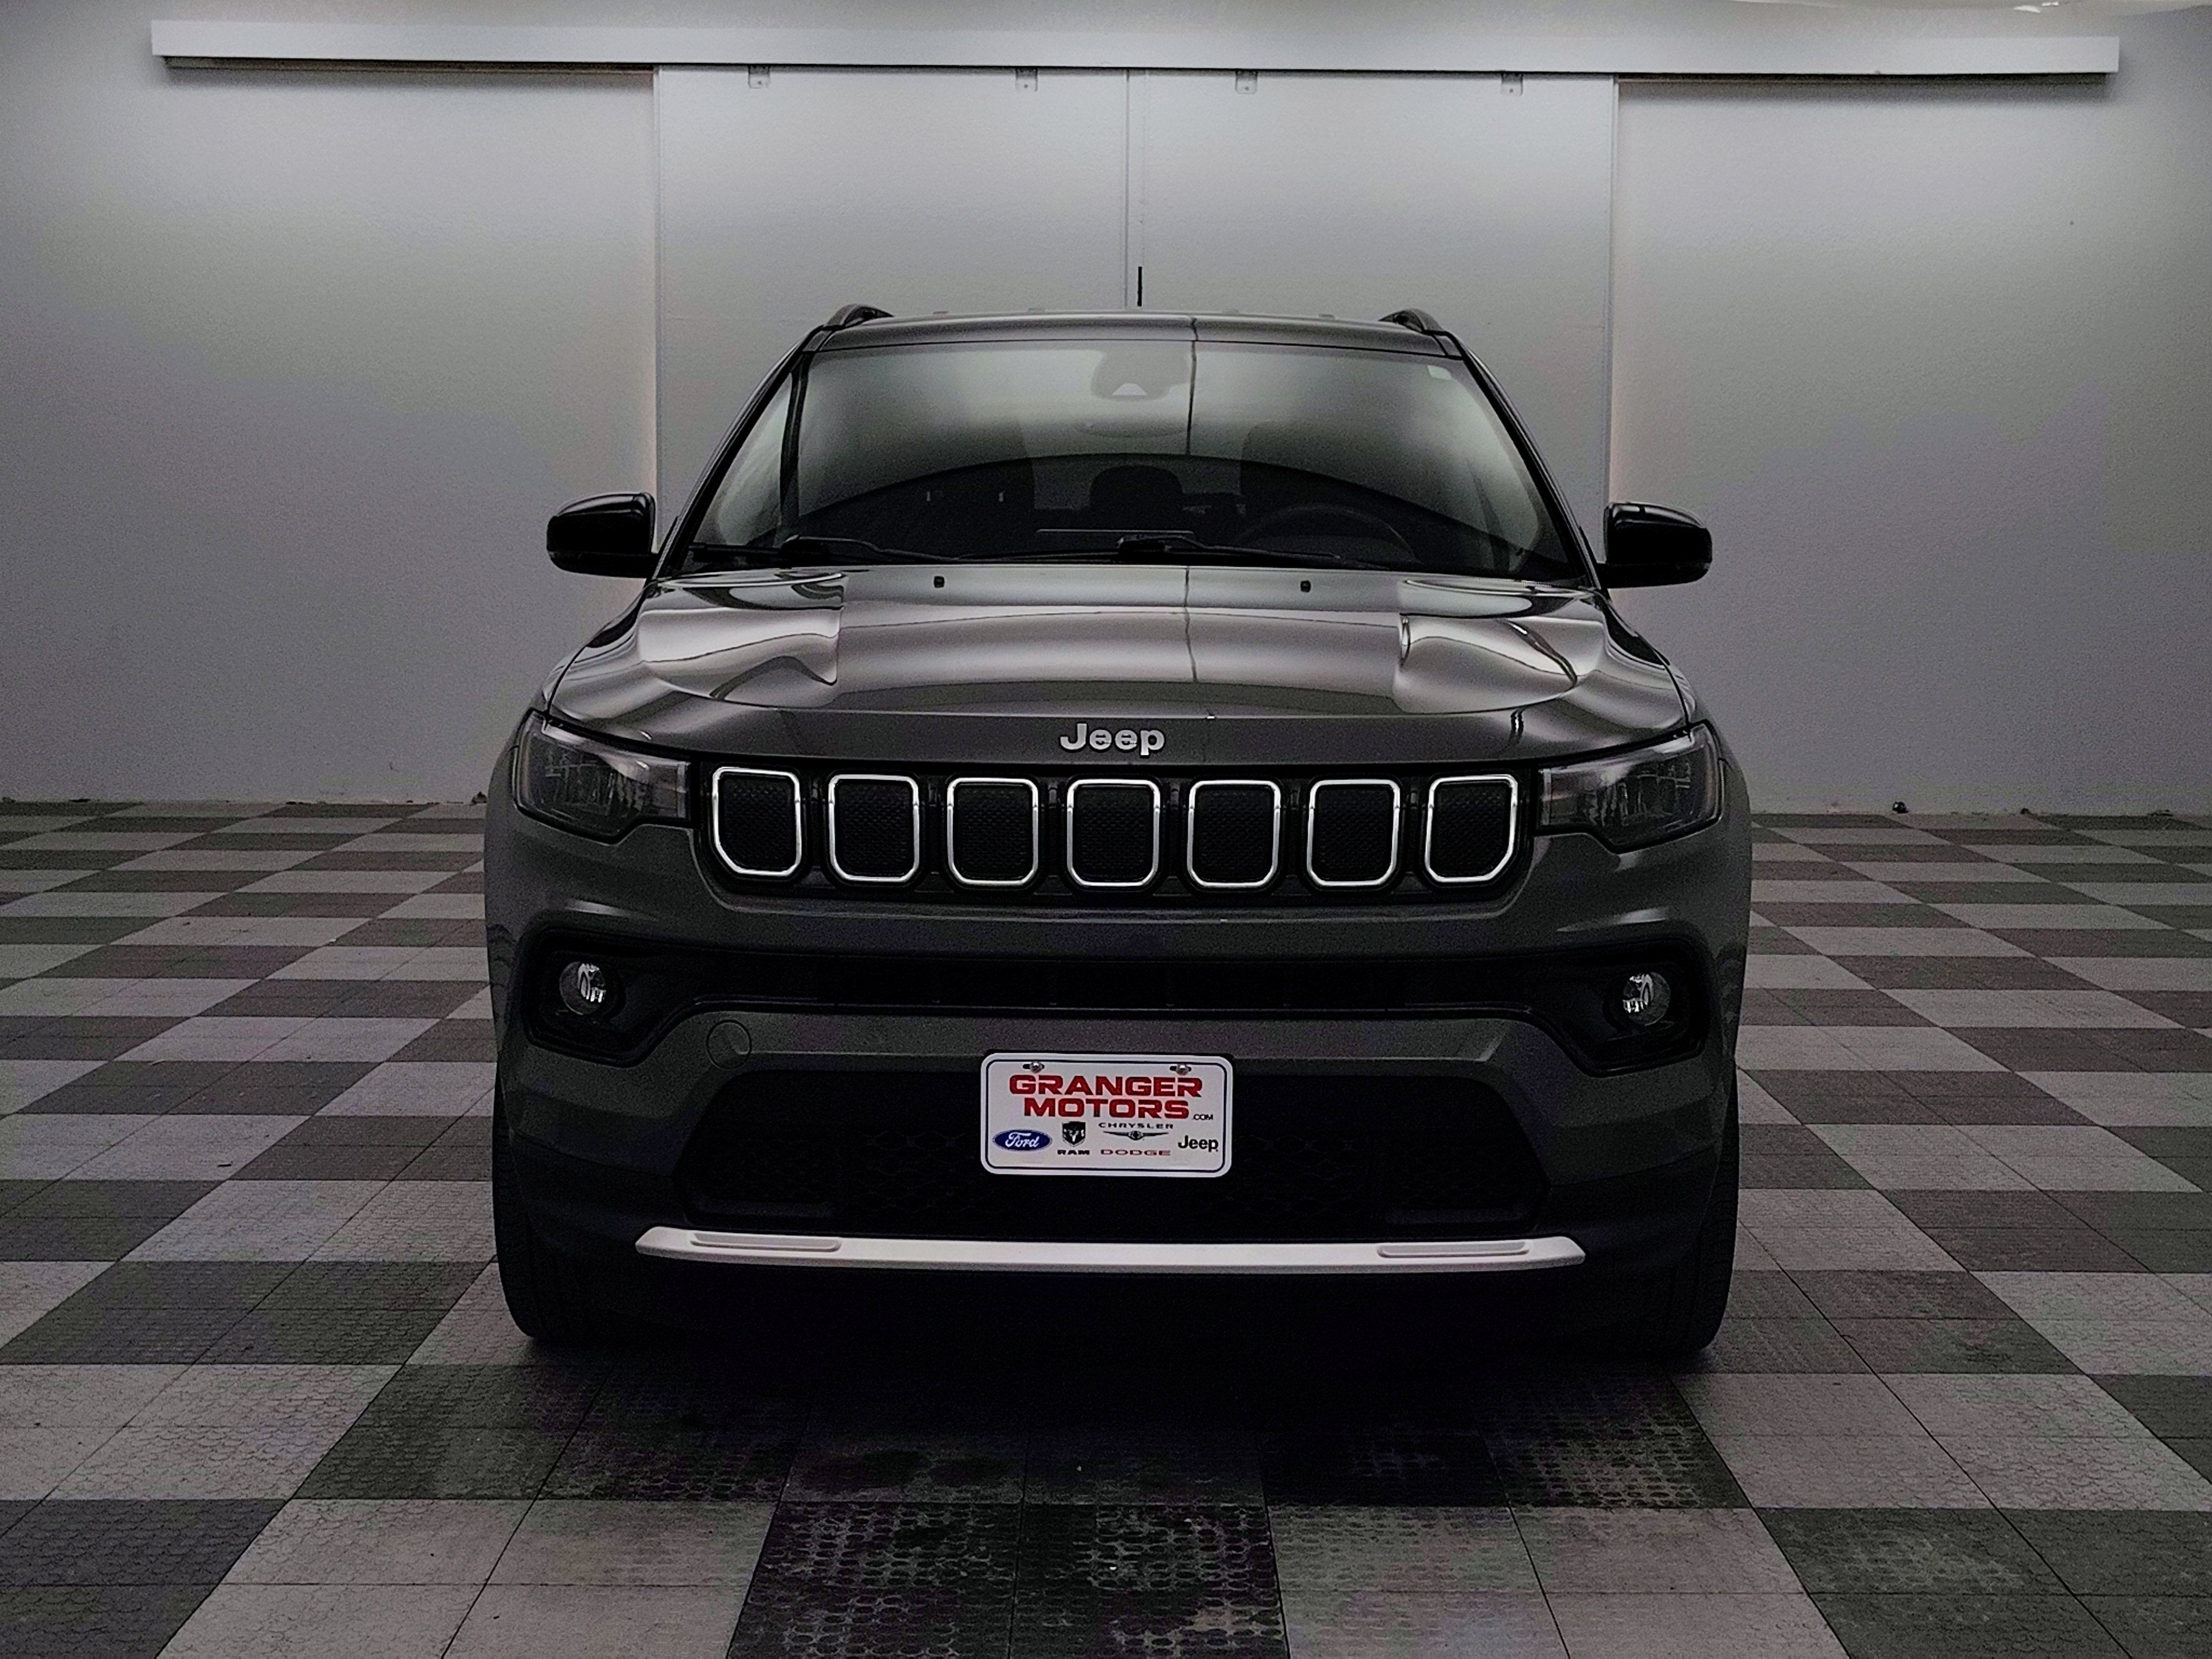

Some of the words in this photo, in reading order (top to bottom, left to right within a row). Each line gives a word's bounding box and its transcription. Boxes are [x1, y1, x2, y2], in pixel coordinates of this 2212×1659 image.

[1059, 723, 1165, 757] Jeep
[1009, 1075, 1202, 1097] GRANGER
[1024, 1097, 1189, 1119] MOTORS
[1005, 1132, 1040, 1148] Ford
[1178, 1135, 1219, 1152] Jeep
